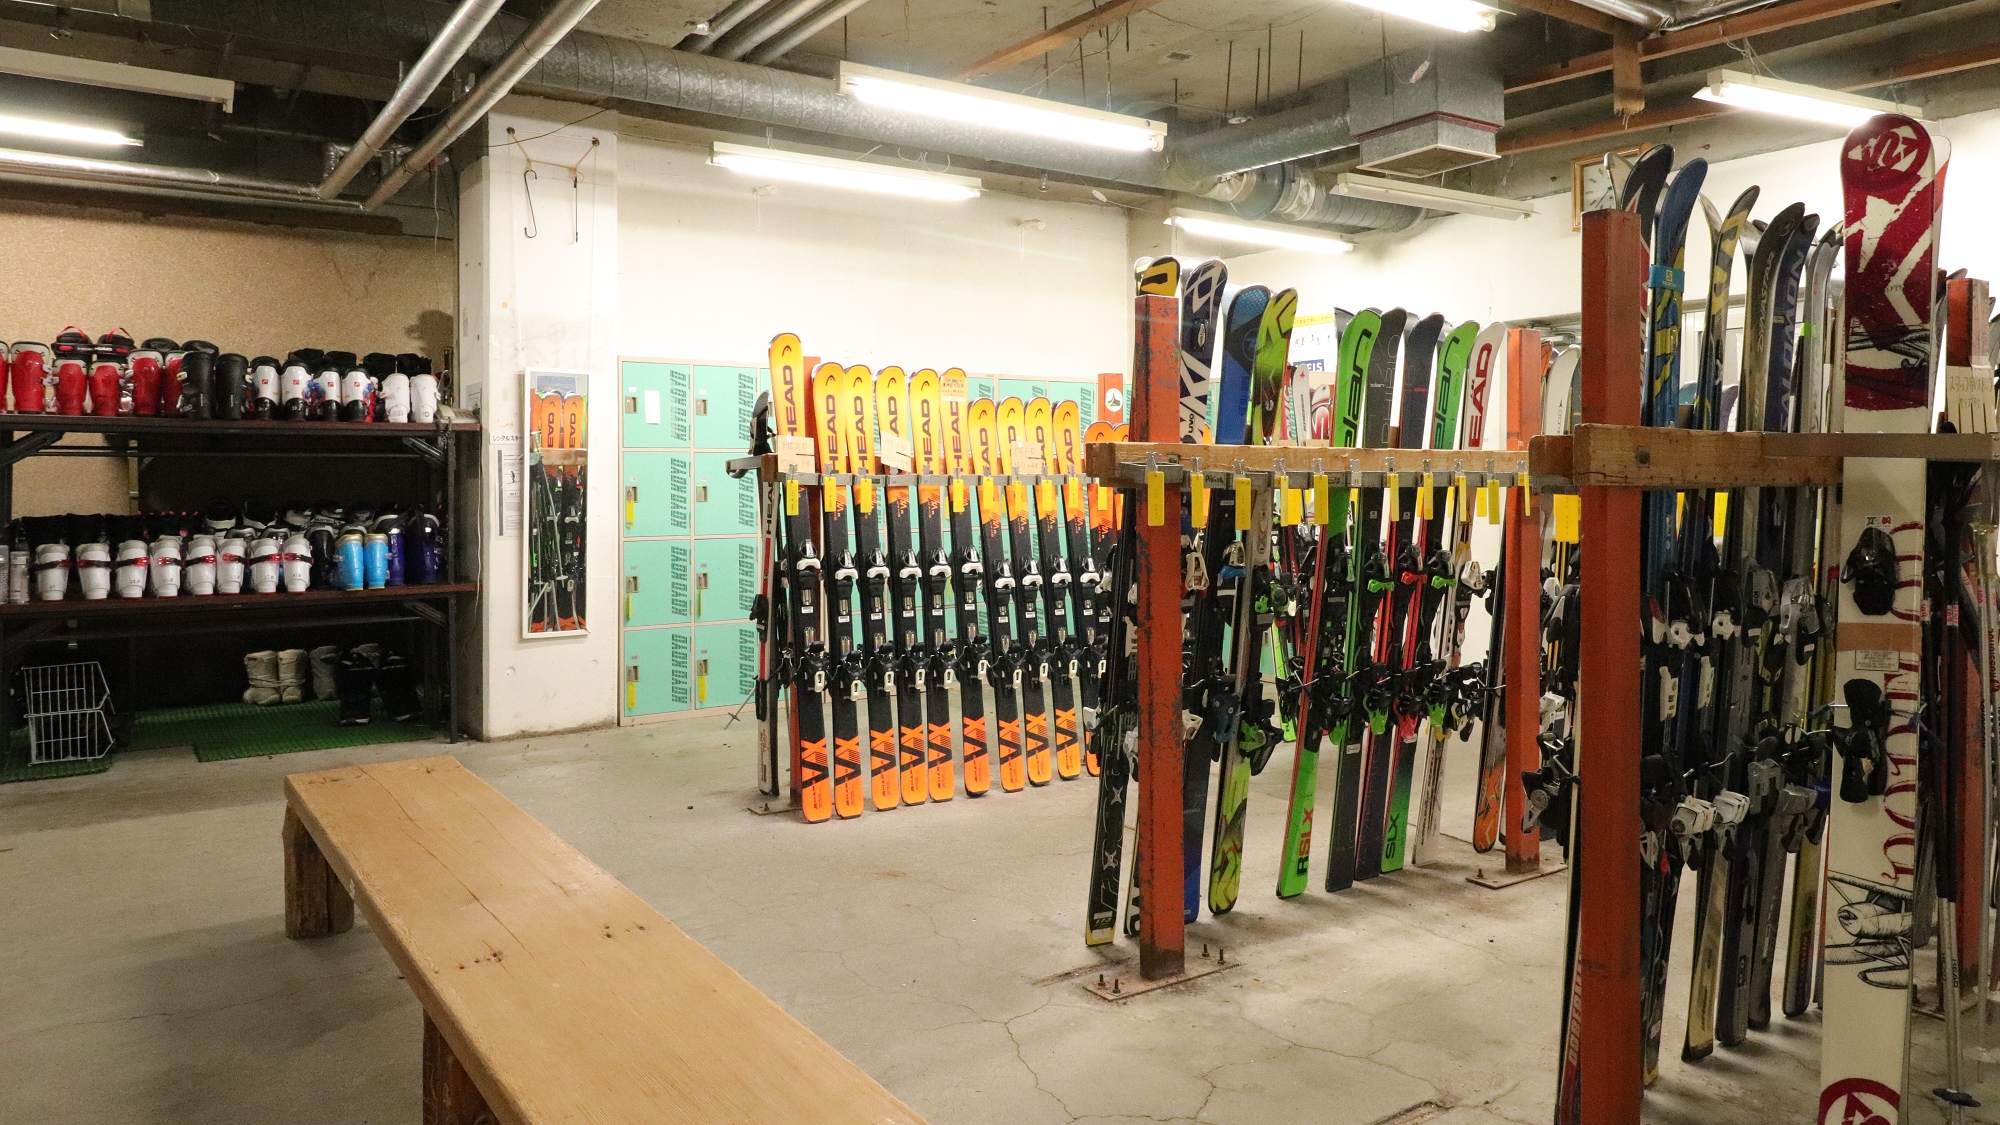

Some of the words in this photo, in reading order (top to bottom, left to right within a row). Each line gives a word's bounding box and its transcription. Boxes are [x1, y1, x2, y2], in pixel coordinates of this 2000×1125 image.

[1757, 251, 1774, 353] DYNASTAR
[888, 396, 899, 437] AD
[1469, 342, 1493, 448] EAD
[825, 394, 839, 474] HEAD
[853, 396, 869, 474] HEAD
[979, 427, 991, 468] AD
[1063, 429, 1075, 469] AD
[1296, 808, 1314, 875] RSLX
[1385, 813, 1401, 859] SLX
